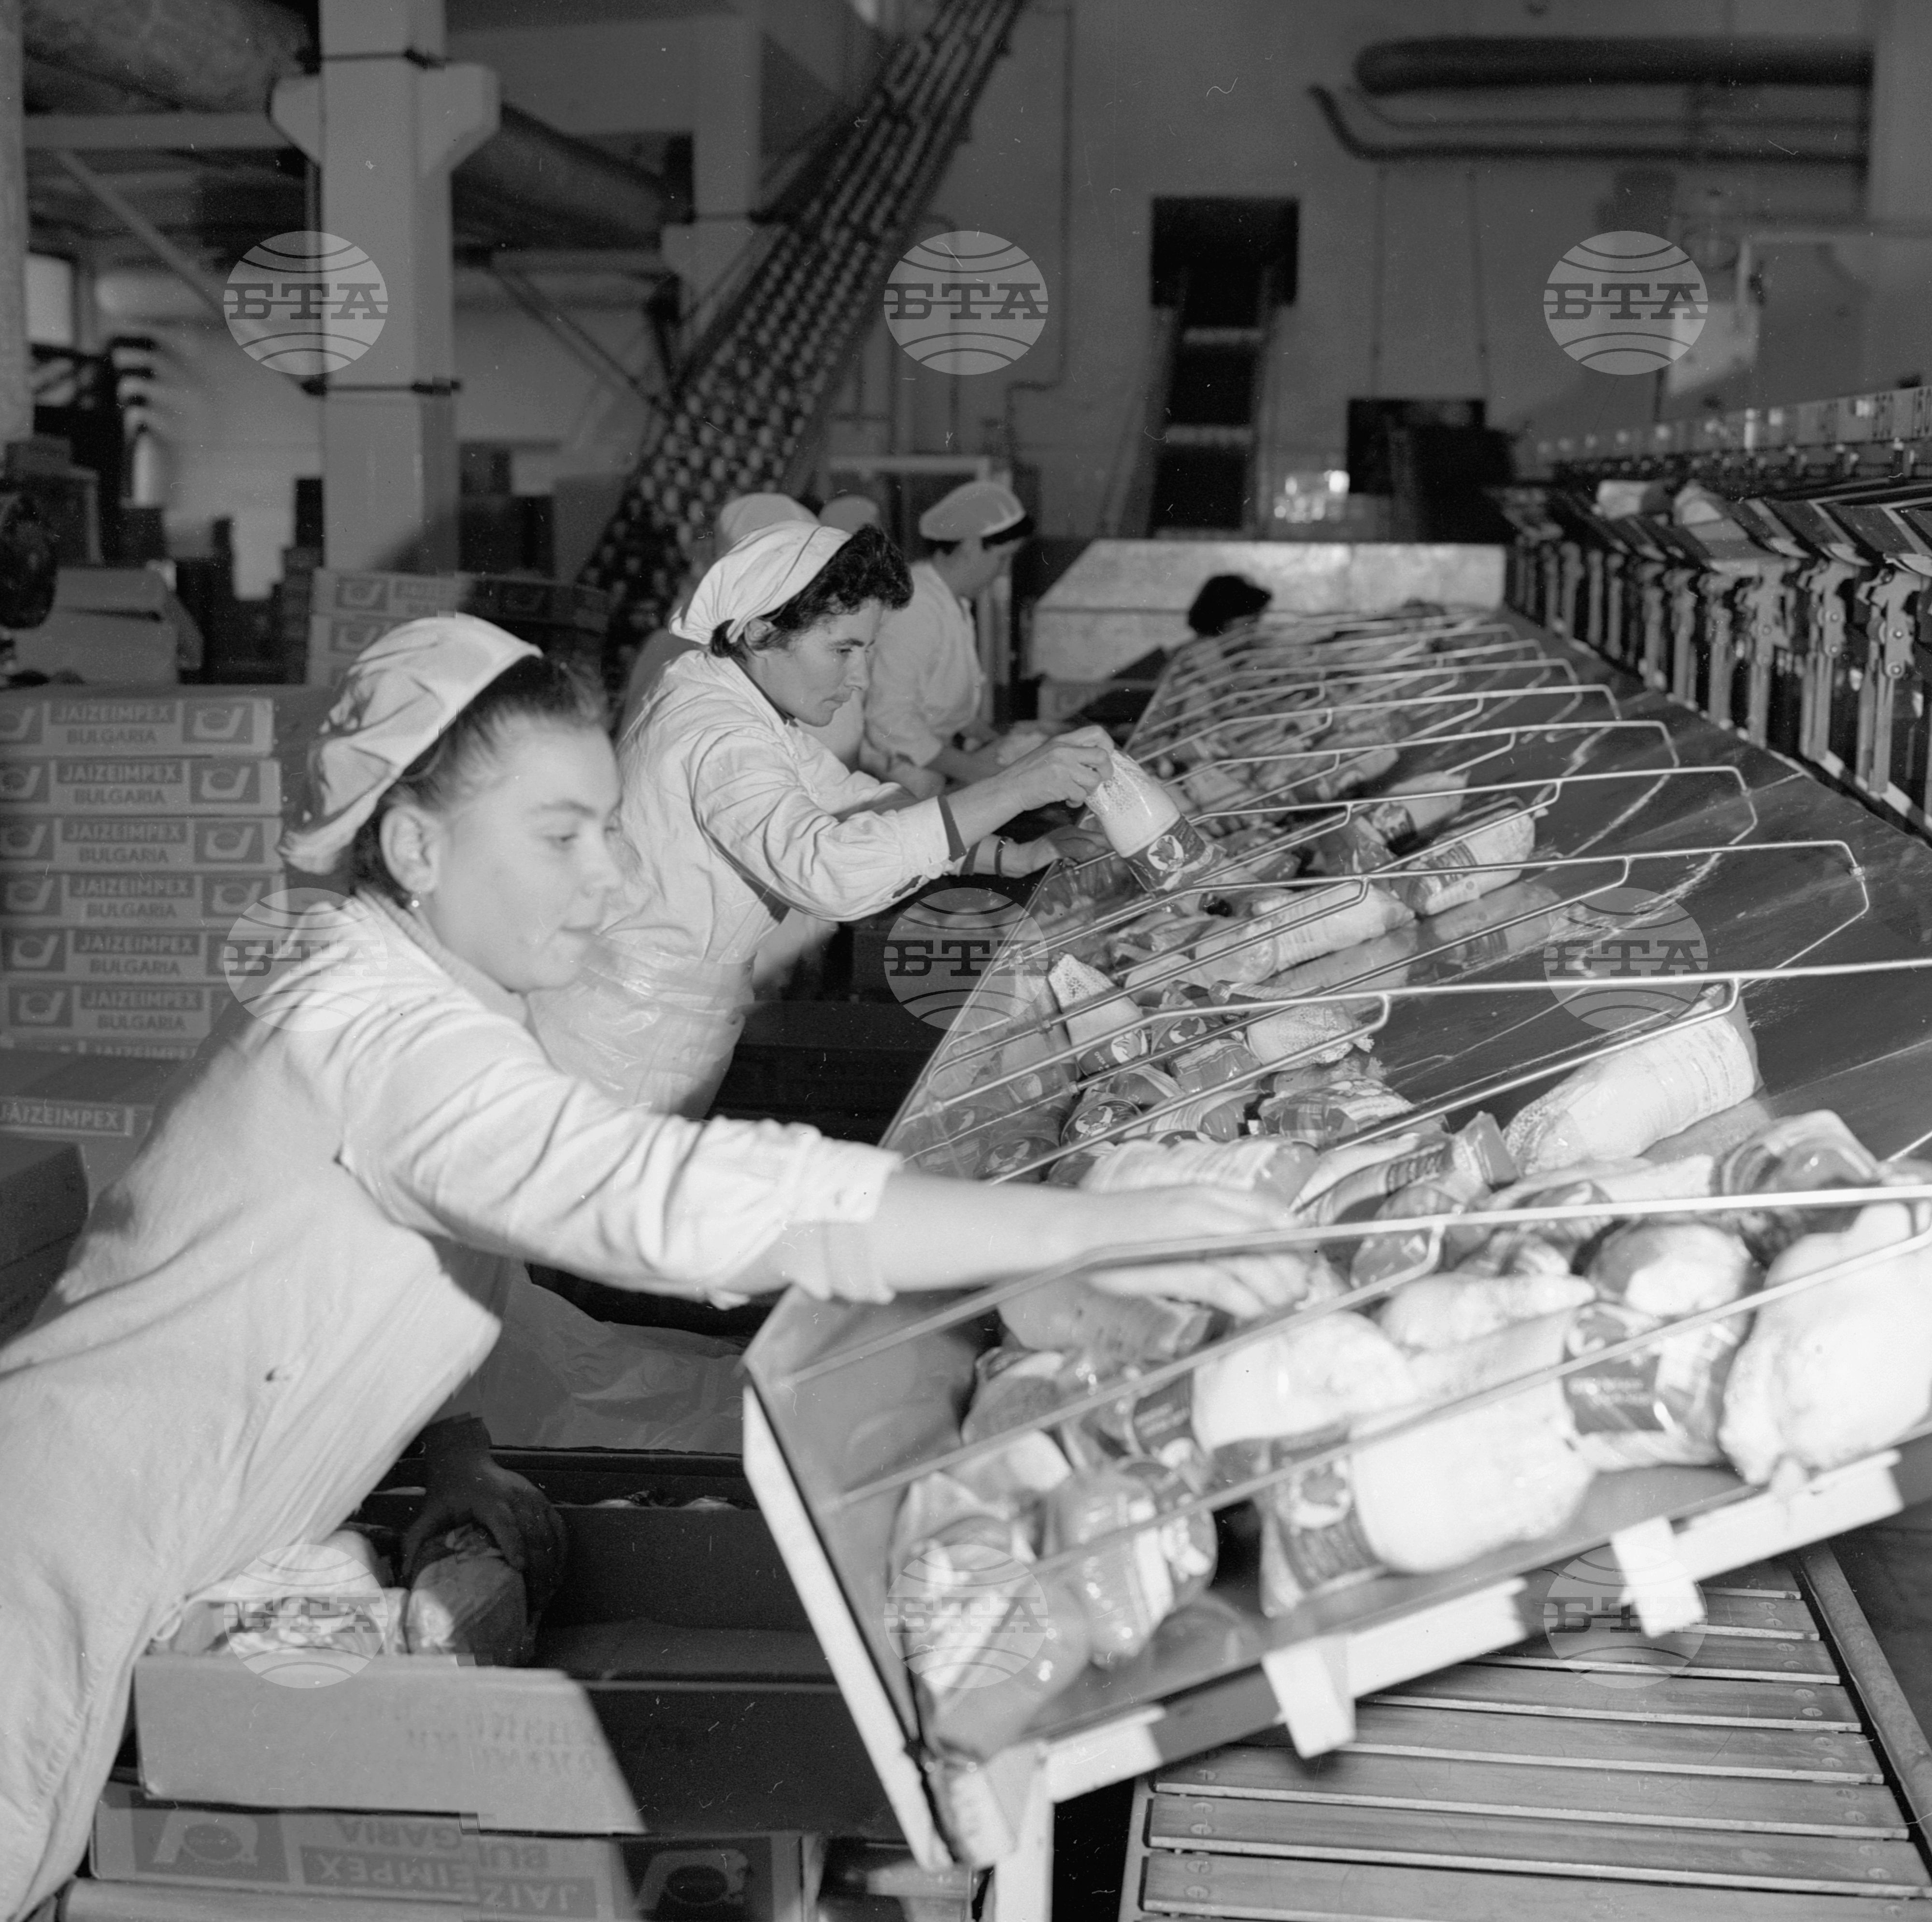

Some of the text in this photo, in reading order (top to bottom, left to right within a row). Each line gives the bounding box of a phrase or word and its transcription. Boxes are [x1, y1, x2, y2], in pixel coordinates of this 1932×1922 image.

[57, 705, 169, 721] JAIZEIMPEX
[66, 728, 157, 744] BULGARIA
[63, 763, 176, 781] JAIZEIMPEX
[74, 788, 166, 804] BULGARIA
[68, 823, 180, 840] JAIZEIMPEX
[78, 847, 169, 863] BULGARIA
[74, 877, 187, 895] JAIZEIMPEX
[86, 901, 177, 918] BULGARIA
[79, 935, 193, 953] JAIZEIMPEX
[90, 958, 181, 975] BULGARIA
[87, 991, 197, 1008] JAIZEIMPEX
[97, 1014, 186, 1029] BULGARIA
